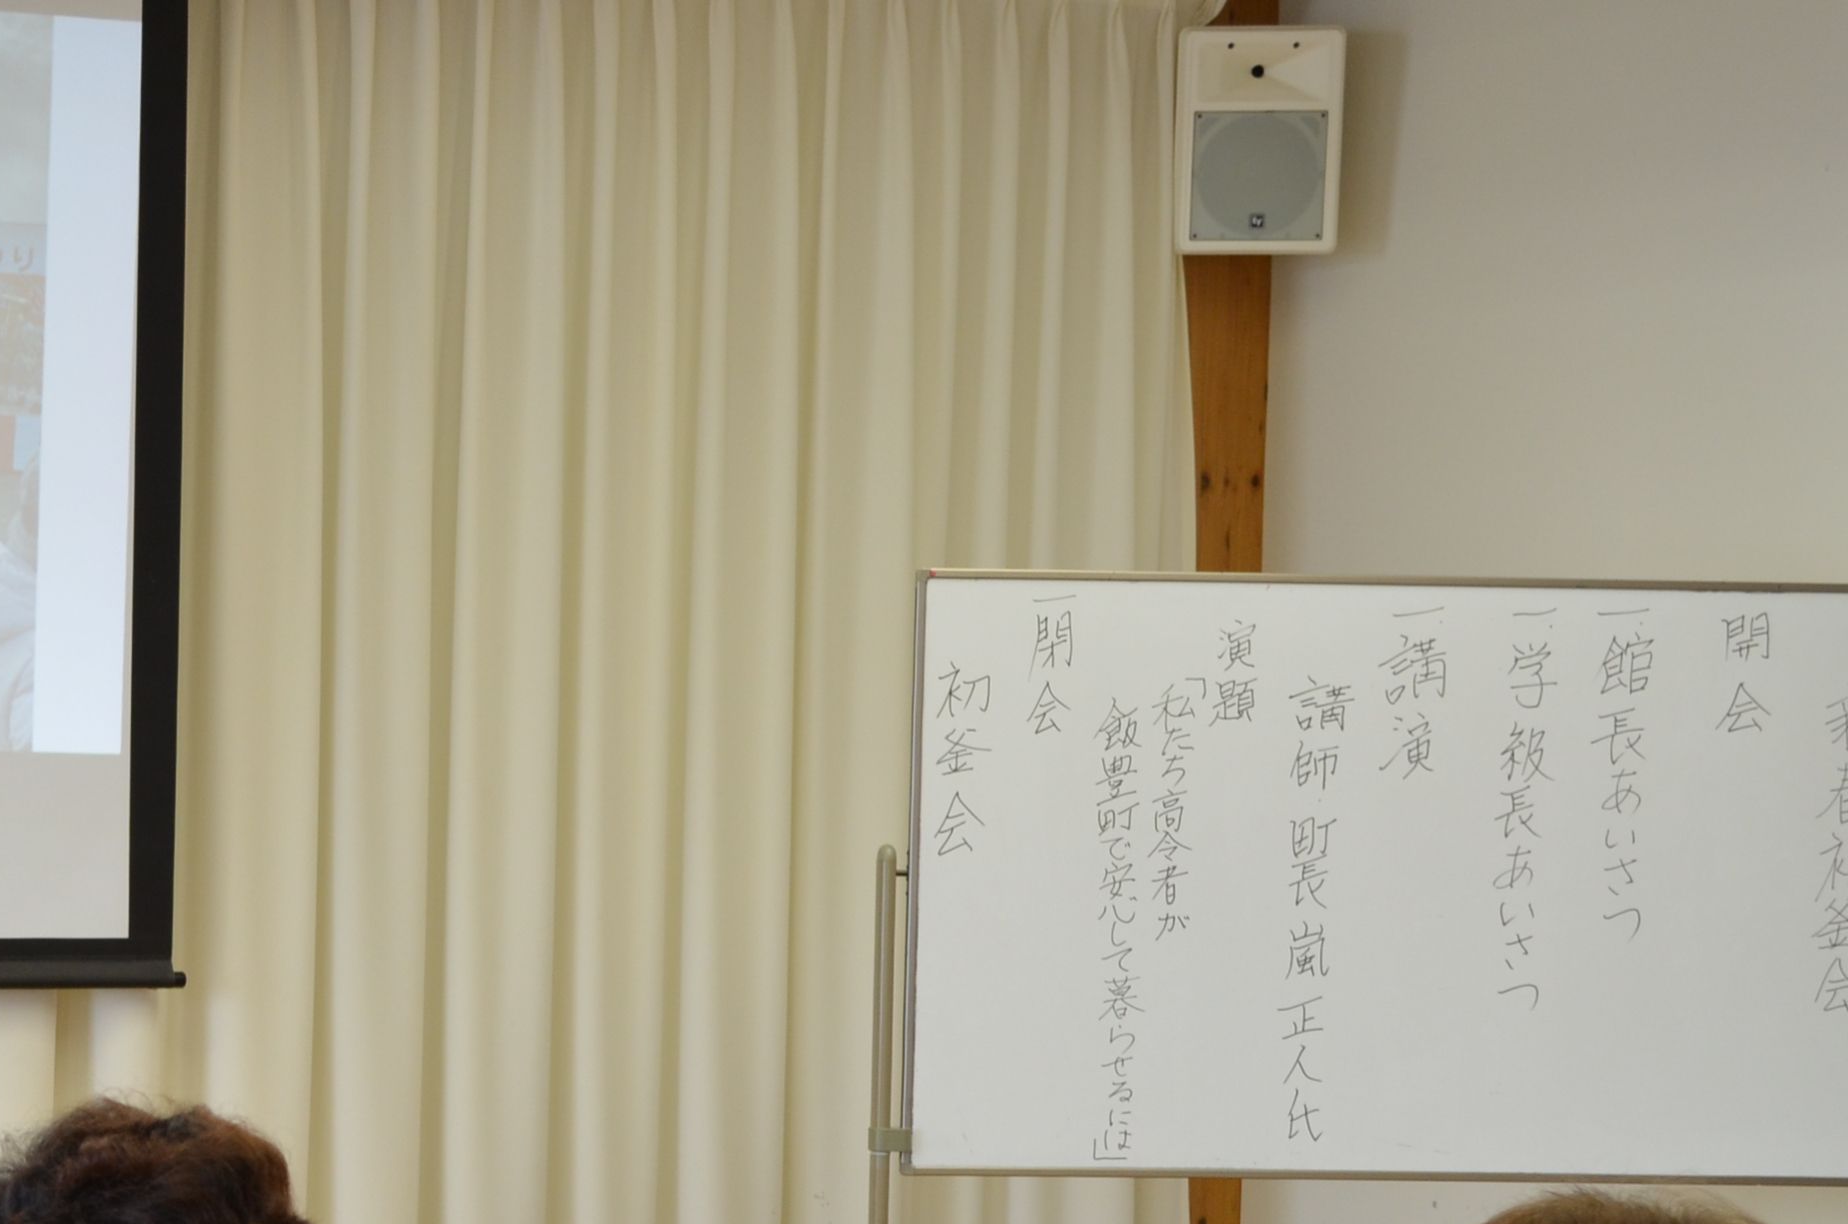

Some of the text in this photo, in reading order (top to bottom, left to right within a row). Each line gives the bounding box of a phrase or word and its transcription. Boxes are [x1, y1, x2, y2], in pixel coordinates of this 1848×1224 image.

[1208, 619, 1258, 728] 演題
[1715, 611, 1772, 734] 開会
[933, 661, 992, 857] 初釜会
